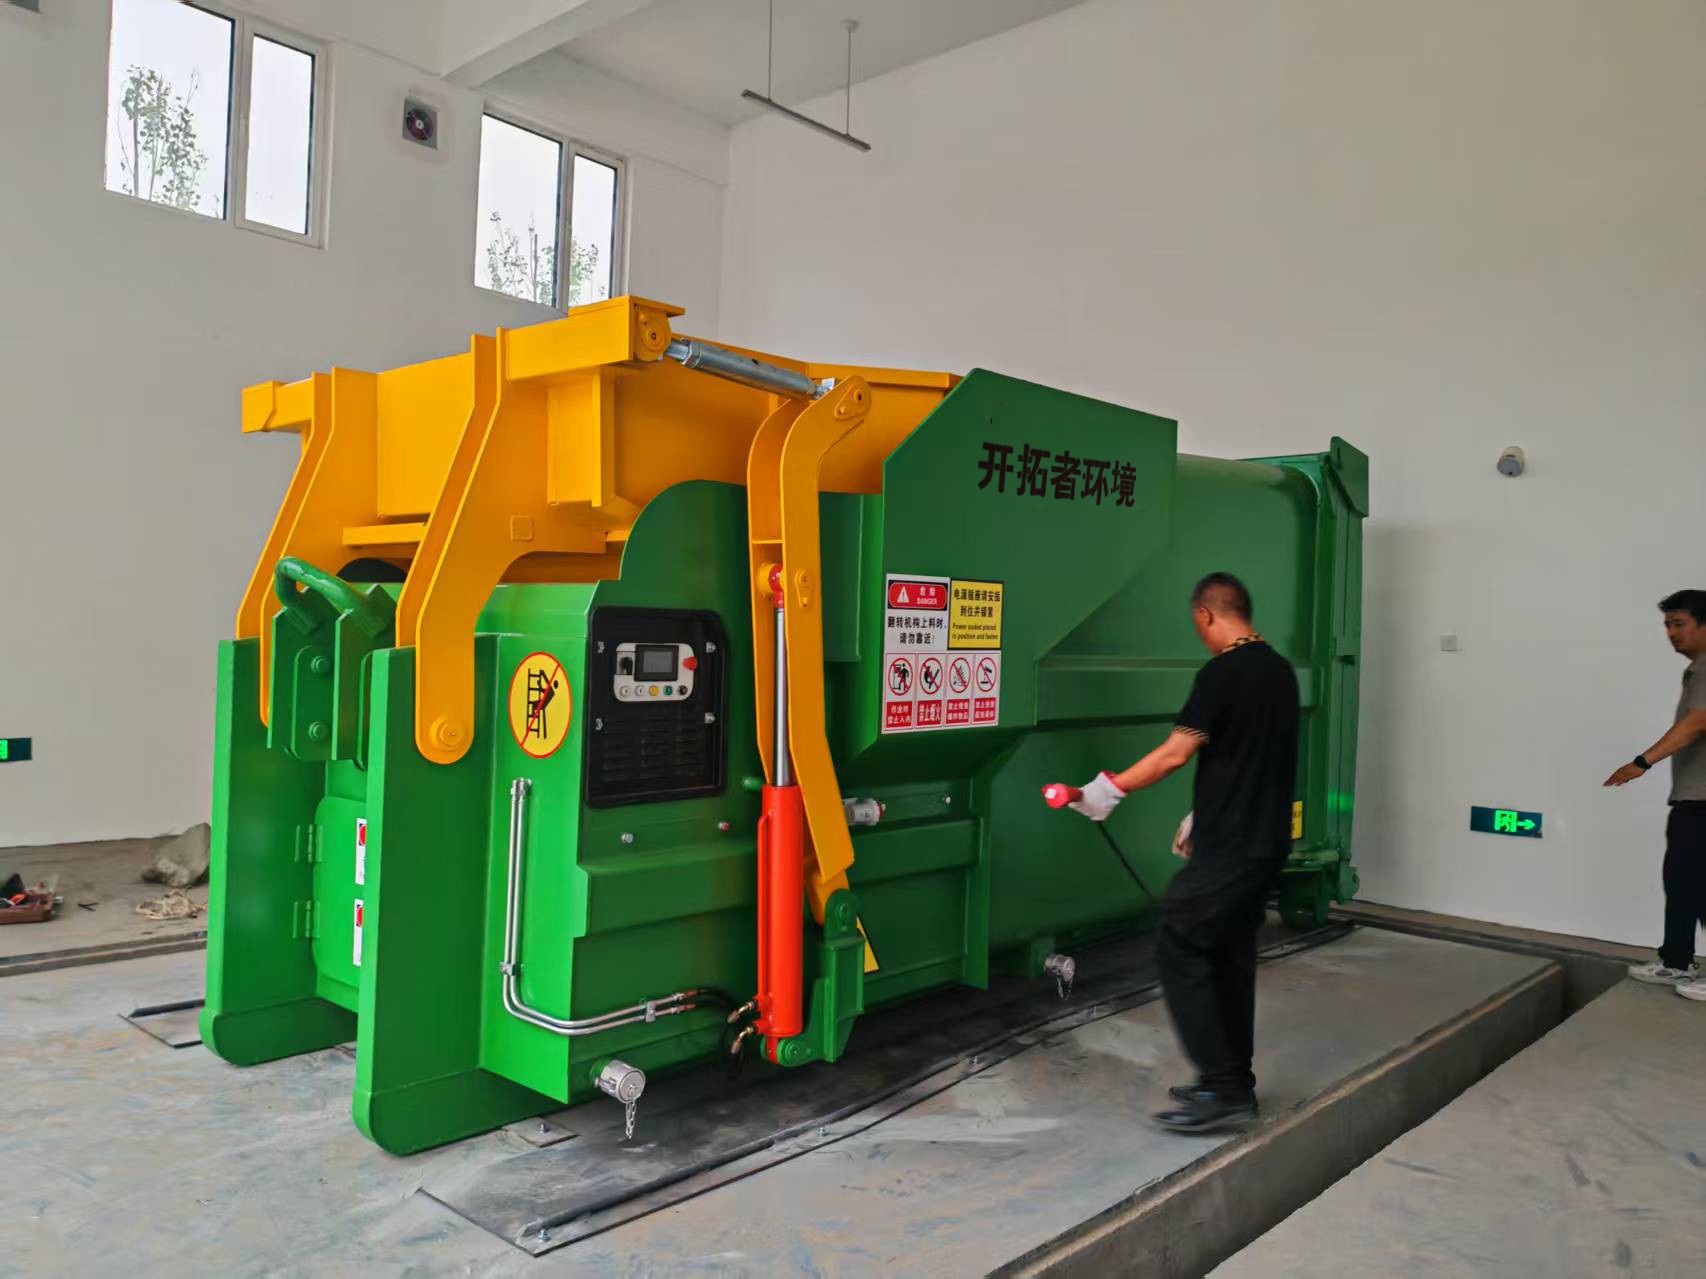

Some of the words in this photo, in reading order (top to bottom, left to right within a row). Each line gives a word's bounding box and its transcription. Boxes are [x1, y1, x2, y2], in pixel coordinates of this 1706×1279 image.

[978, 442, 1137, 507] 开拓者环境
[917, 597, 938, 605] DANGER
[919, 703, 941, 722] 禁止烟火
